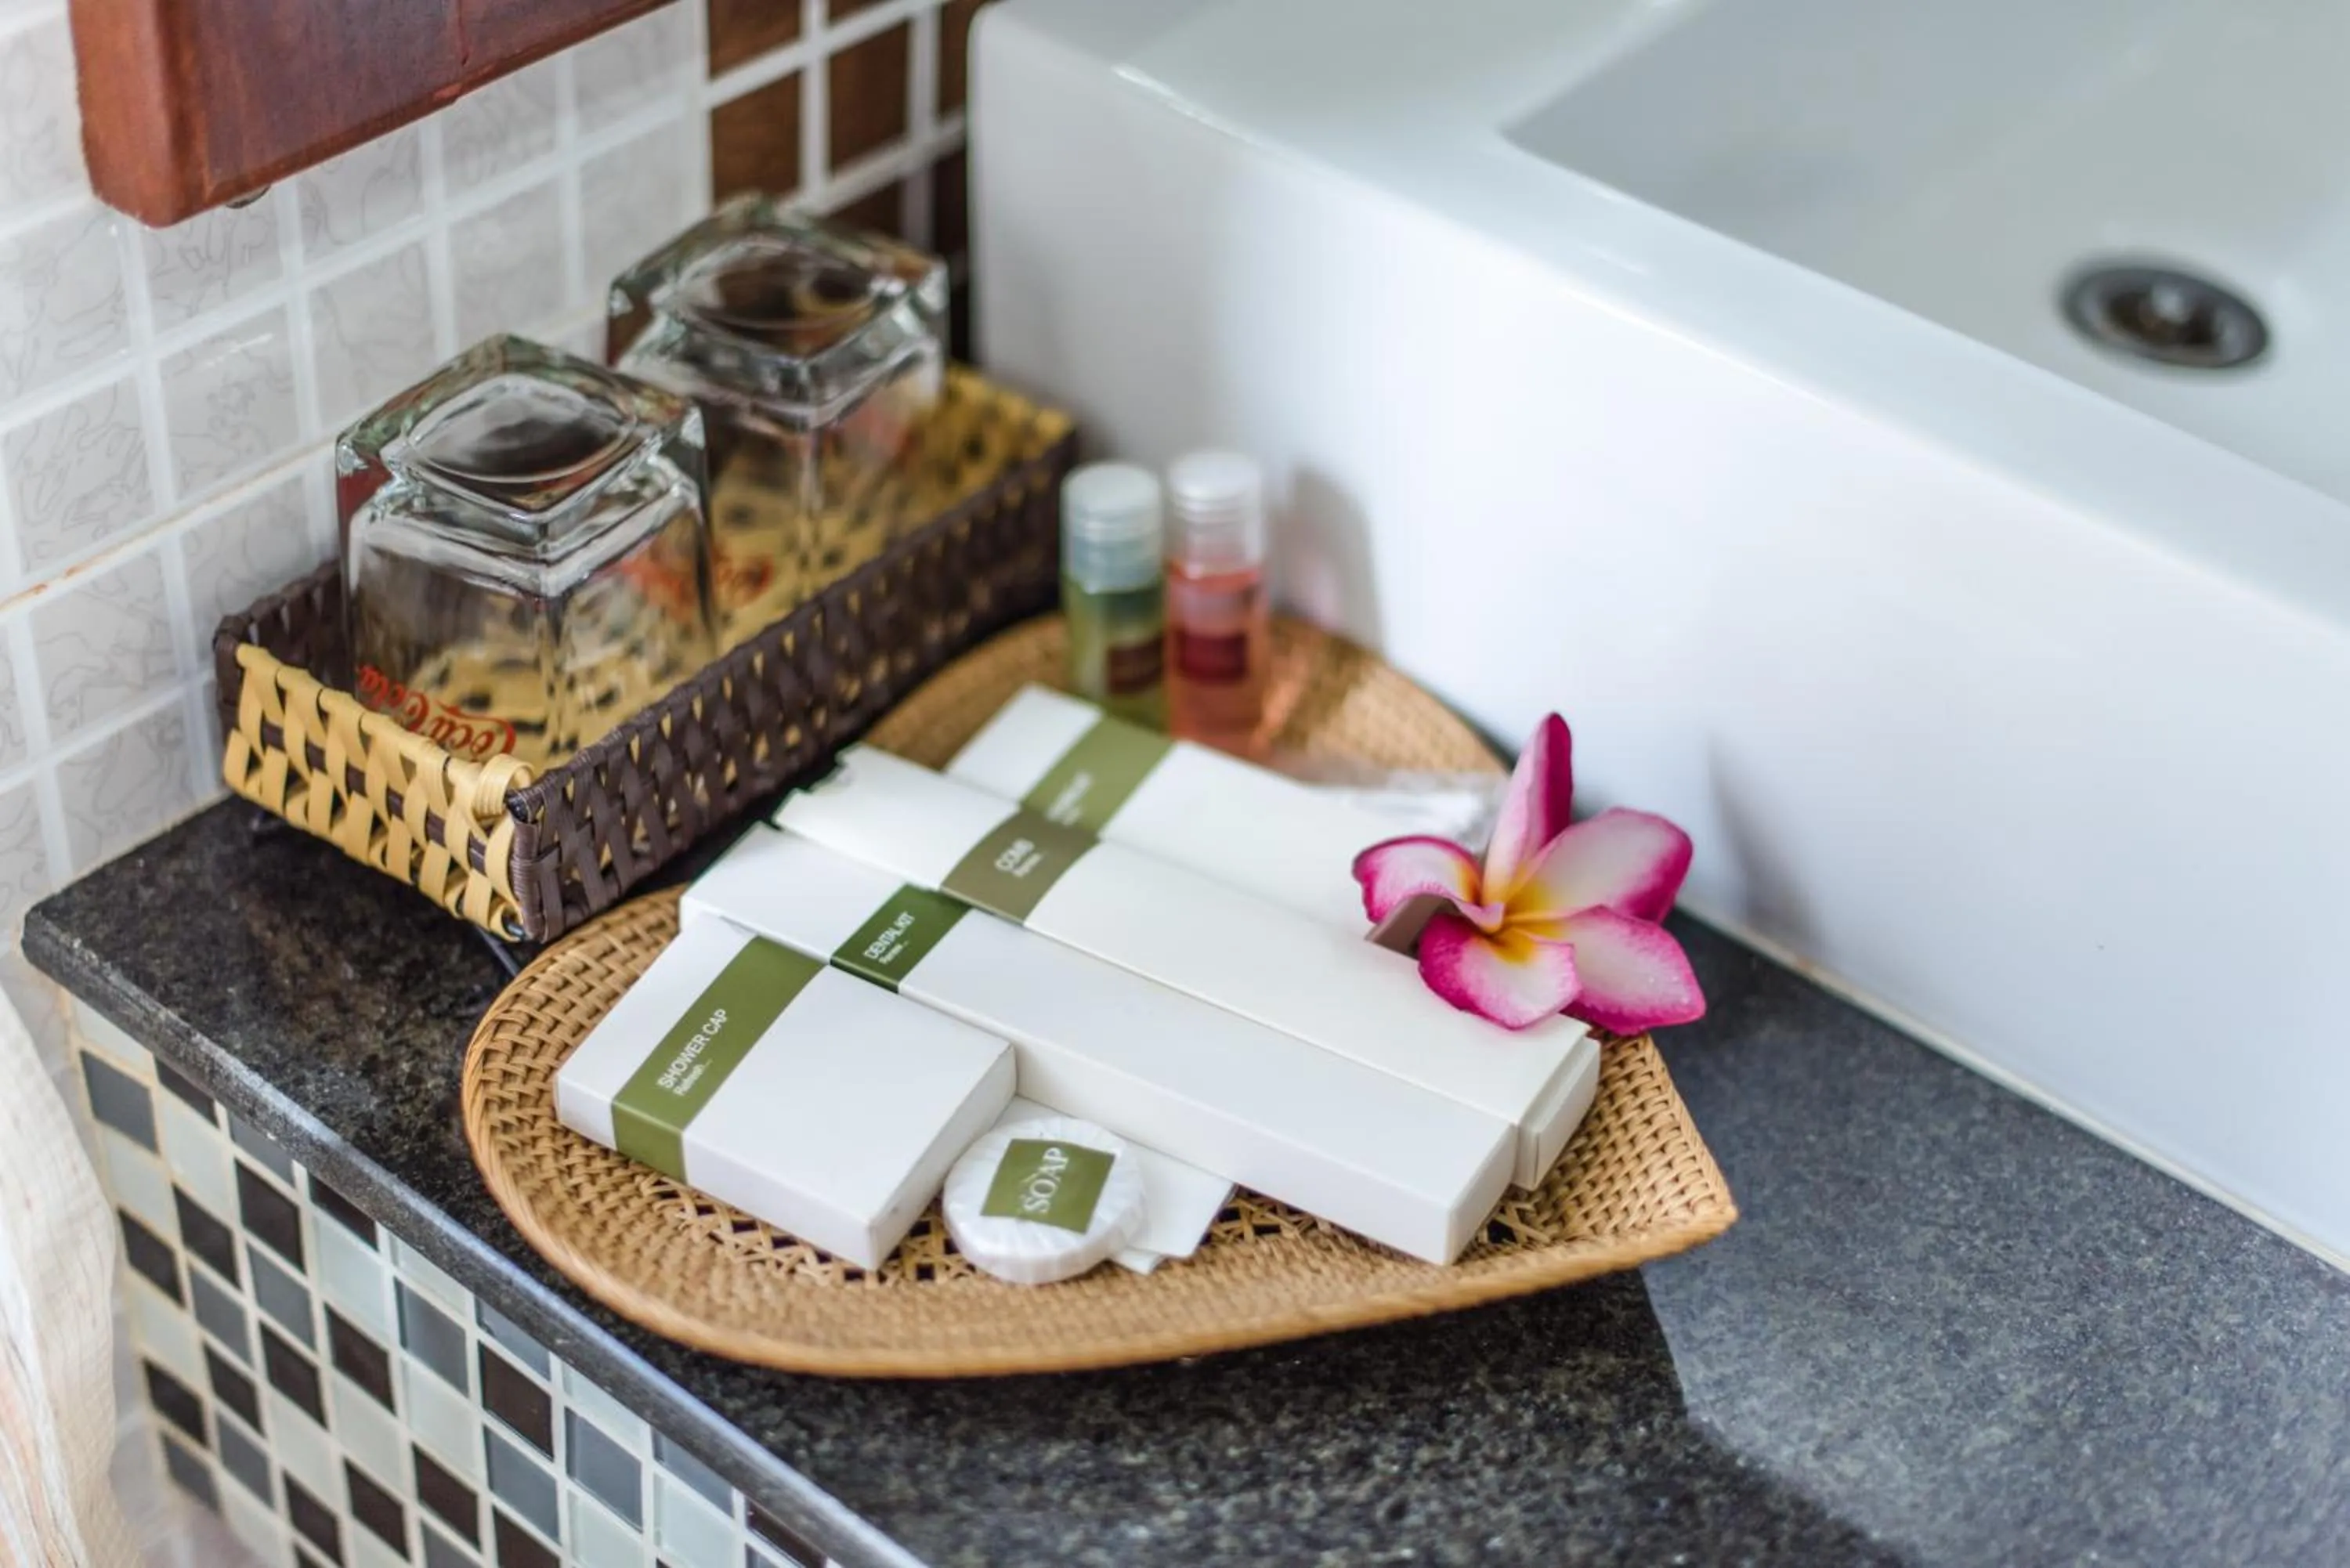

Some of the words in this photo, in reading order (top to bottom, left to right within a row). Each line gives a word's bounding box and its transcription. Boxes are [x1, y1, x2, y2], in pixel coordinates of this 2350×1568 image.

[656, 1034, 710, 1089] SHOWER
[703, 1008, 728, 1036] CAP
[1023, 1147, 1070, 1213] SOAP
